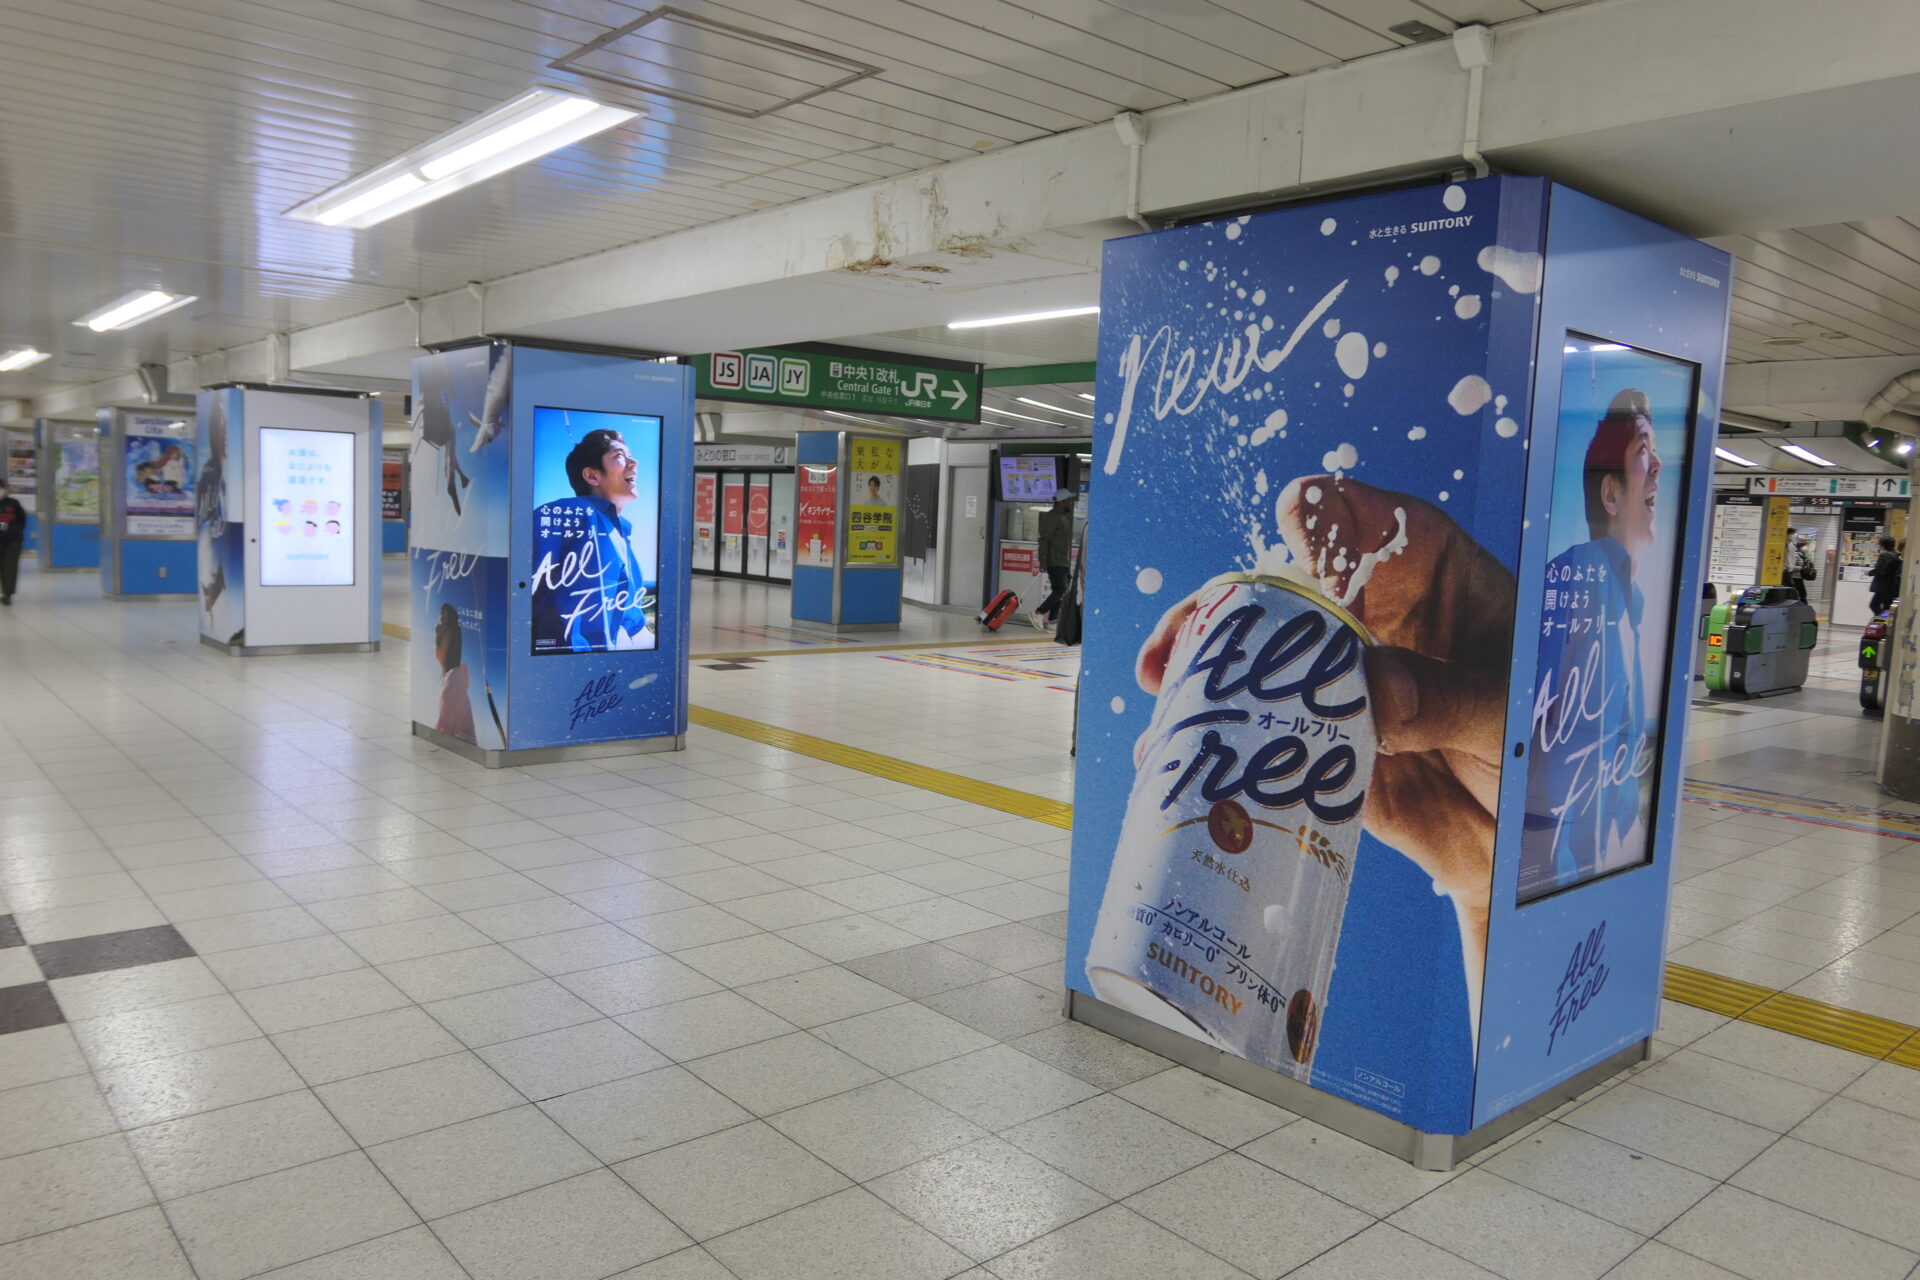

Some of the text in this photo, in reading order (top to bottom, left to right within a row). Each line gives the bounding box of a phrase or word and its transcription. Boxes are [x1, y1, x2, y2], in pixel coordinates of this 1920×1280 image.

[1369, 215, 1474, 239] 水と生きる SUNTORY
[719, 361, 736, 378] JS
[751, 365, 771, 382] JA
[785, 369, 803, 385] JY
[843, 363, 900, 384] 中央1改札
[837, 380, 899, 396] Central Gate 1
[901, 371, 938, 400] JR
[905, 399, 933, 408] JR東日本
[696, 448, 736, 462] みどりの窓口
[540, 505, 595, 516] 心のふたを
[540, 516, 581, 528] 開けよう
[851, 511, 893, 524] 四谷学院
[540, 528, 607, 539] オールフリー
[532, 540, 612, 595] All
[1547, 563, 1608, 584] 心のふたを
[560, 580, 657, 641] Free
[1544, 589, 1591, 611] 開けよう
[1542, 615, 1617, 637] オールフリー
[1709, 634, 1723, 646] IC
[1162, 604, 1367, 721] All
[574, 673, 616, 708] All
[1531, 640, 1620, 752] All
[569, 694, 624, 730] Free
[1257, 711, 1351, 743] オールフリー
[1155, 709, 1366, 825] Free
[1550, 721, 1654, 862] Free
[1191, 849, 1252, 893] 天然水仕込
[1162, 899, 1252, 960] ノンアルコール
[1555, 919, 1607, 1007] All
[1146, 942, 1246, 1017] SUNTORY
[1547, 963, 1610, 1057] Free
[1356, 1070, 1402, 1093] ノンアルコール
